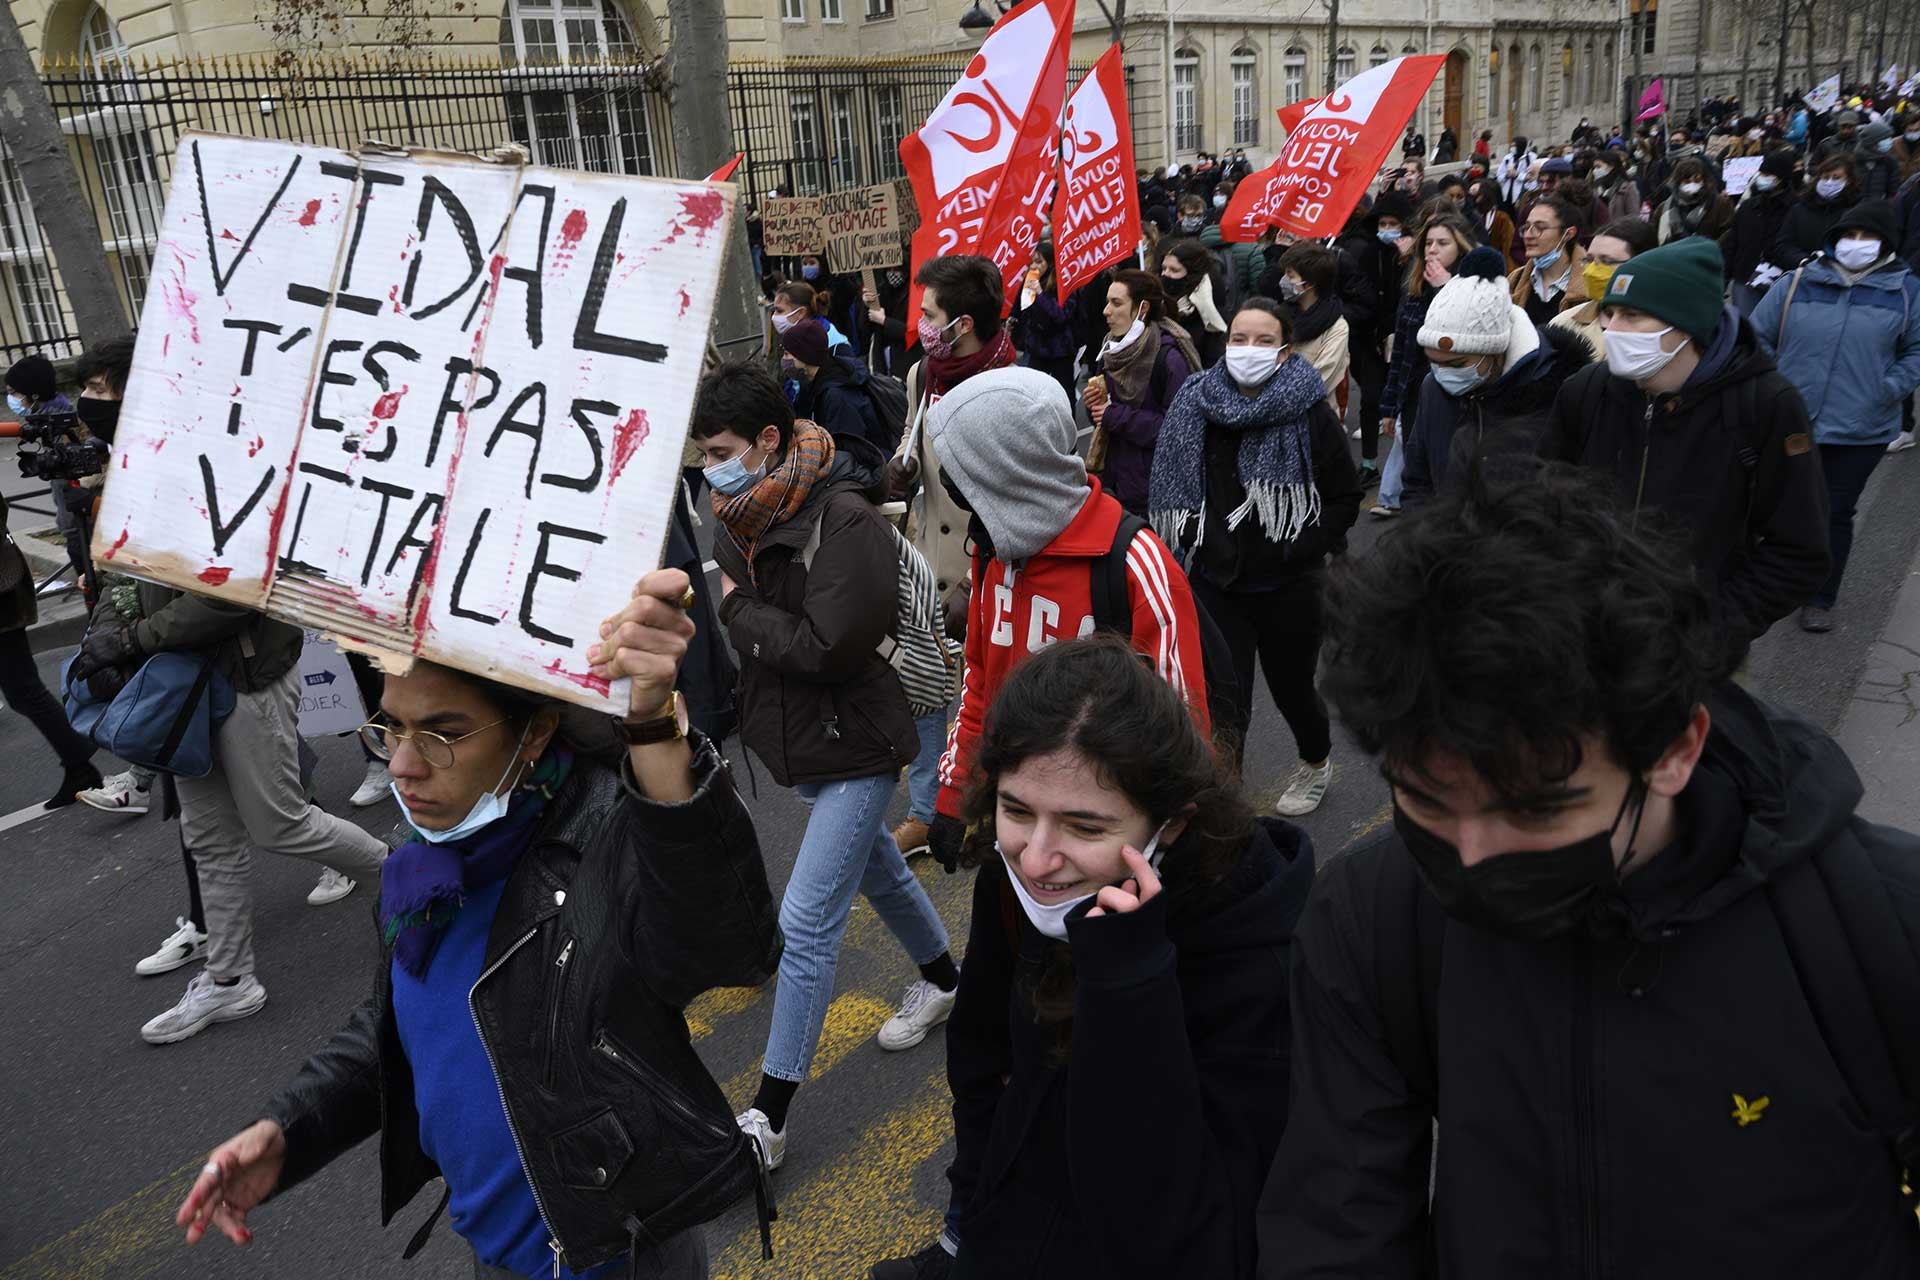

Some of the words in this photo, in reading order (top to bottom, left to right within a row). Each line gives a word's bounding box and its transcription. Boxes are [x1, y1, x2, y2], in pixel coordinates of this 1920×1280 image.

[193, 140, 669, 362] VIDAL
[826, 234, 862, 272] NOUS
[828, 207, 887, 235] CHÔMAGE
[222, 319, 422, 462] T'ES
[425, 356, 622, 500] PAS
[199, 453, 609, 648] VITALE
